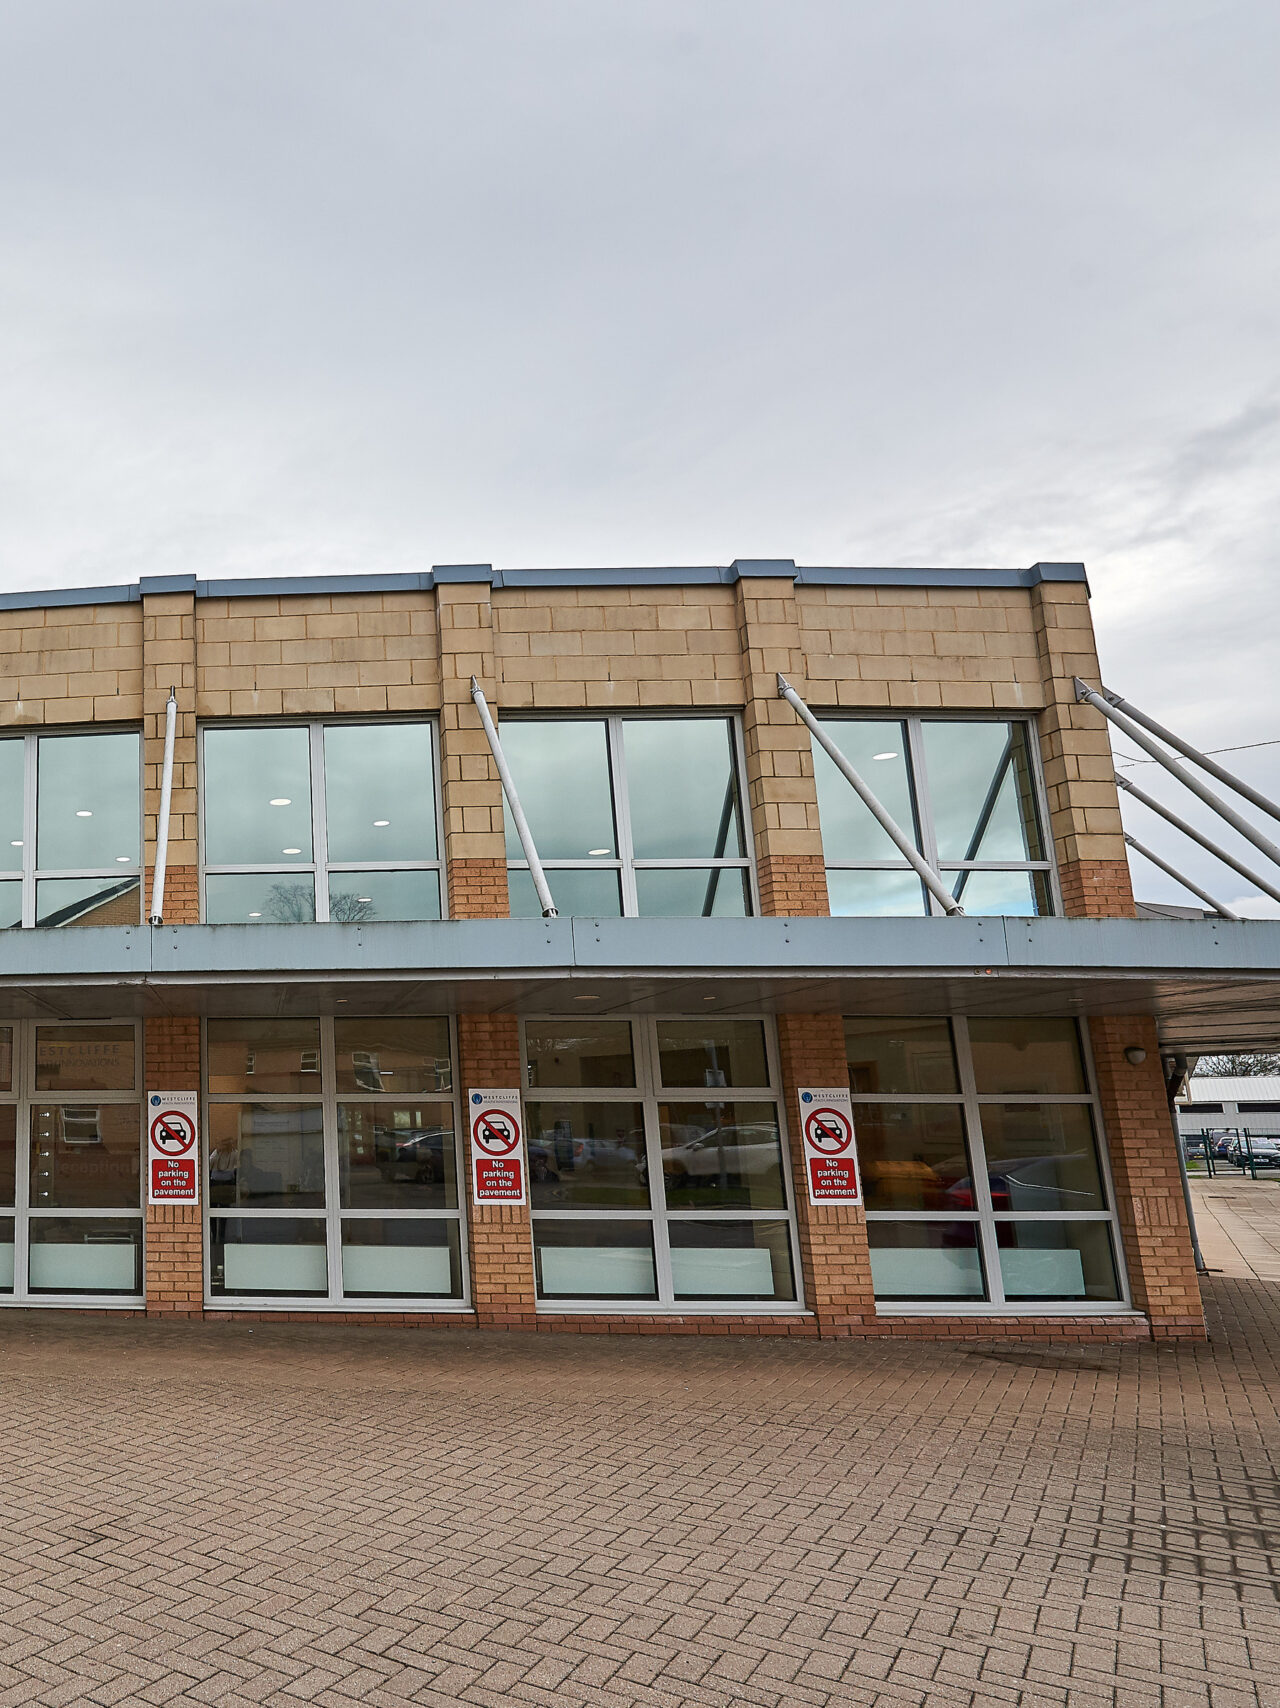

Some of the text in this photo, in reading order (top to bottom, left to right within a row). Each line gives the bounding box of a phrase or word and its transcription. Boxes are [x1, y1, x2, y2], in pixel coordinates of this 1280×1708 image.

[39, 1044, 120, 1056] ESTCLIFFE
[167, 1160, 179, 1168] No
[492, 1160, 504, 1168] No
[826, 1159, 838, 1167] No
[158, 1169, 189, 1178] parking
[483, 1169, 515, 1179] parking
[817, 1168, 849, 1178] parking
[173, 1178, 186, 1186] the
[486, 1178, 512, 1187] on the
[833, 1178, 847, 1186] the
[154, 1188, 194, 1197] pavement
[479, 1188, 520, 1197] pavement
[815, 1187, 856, 1196] pavement
